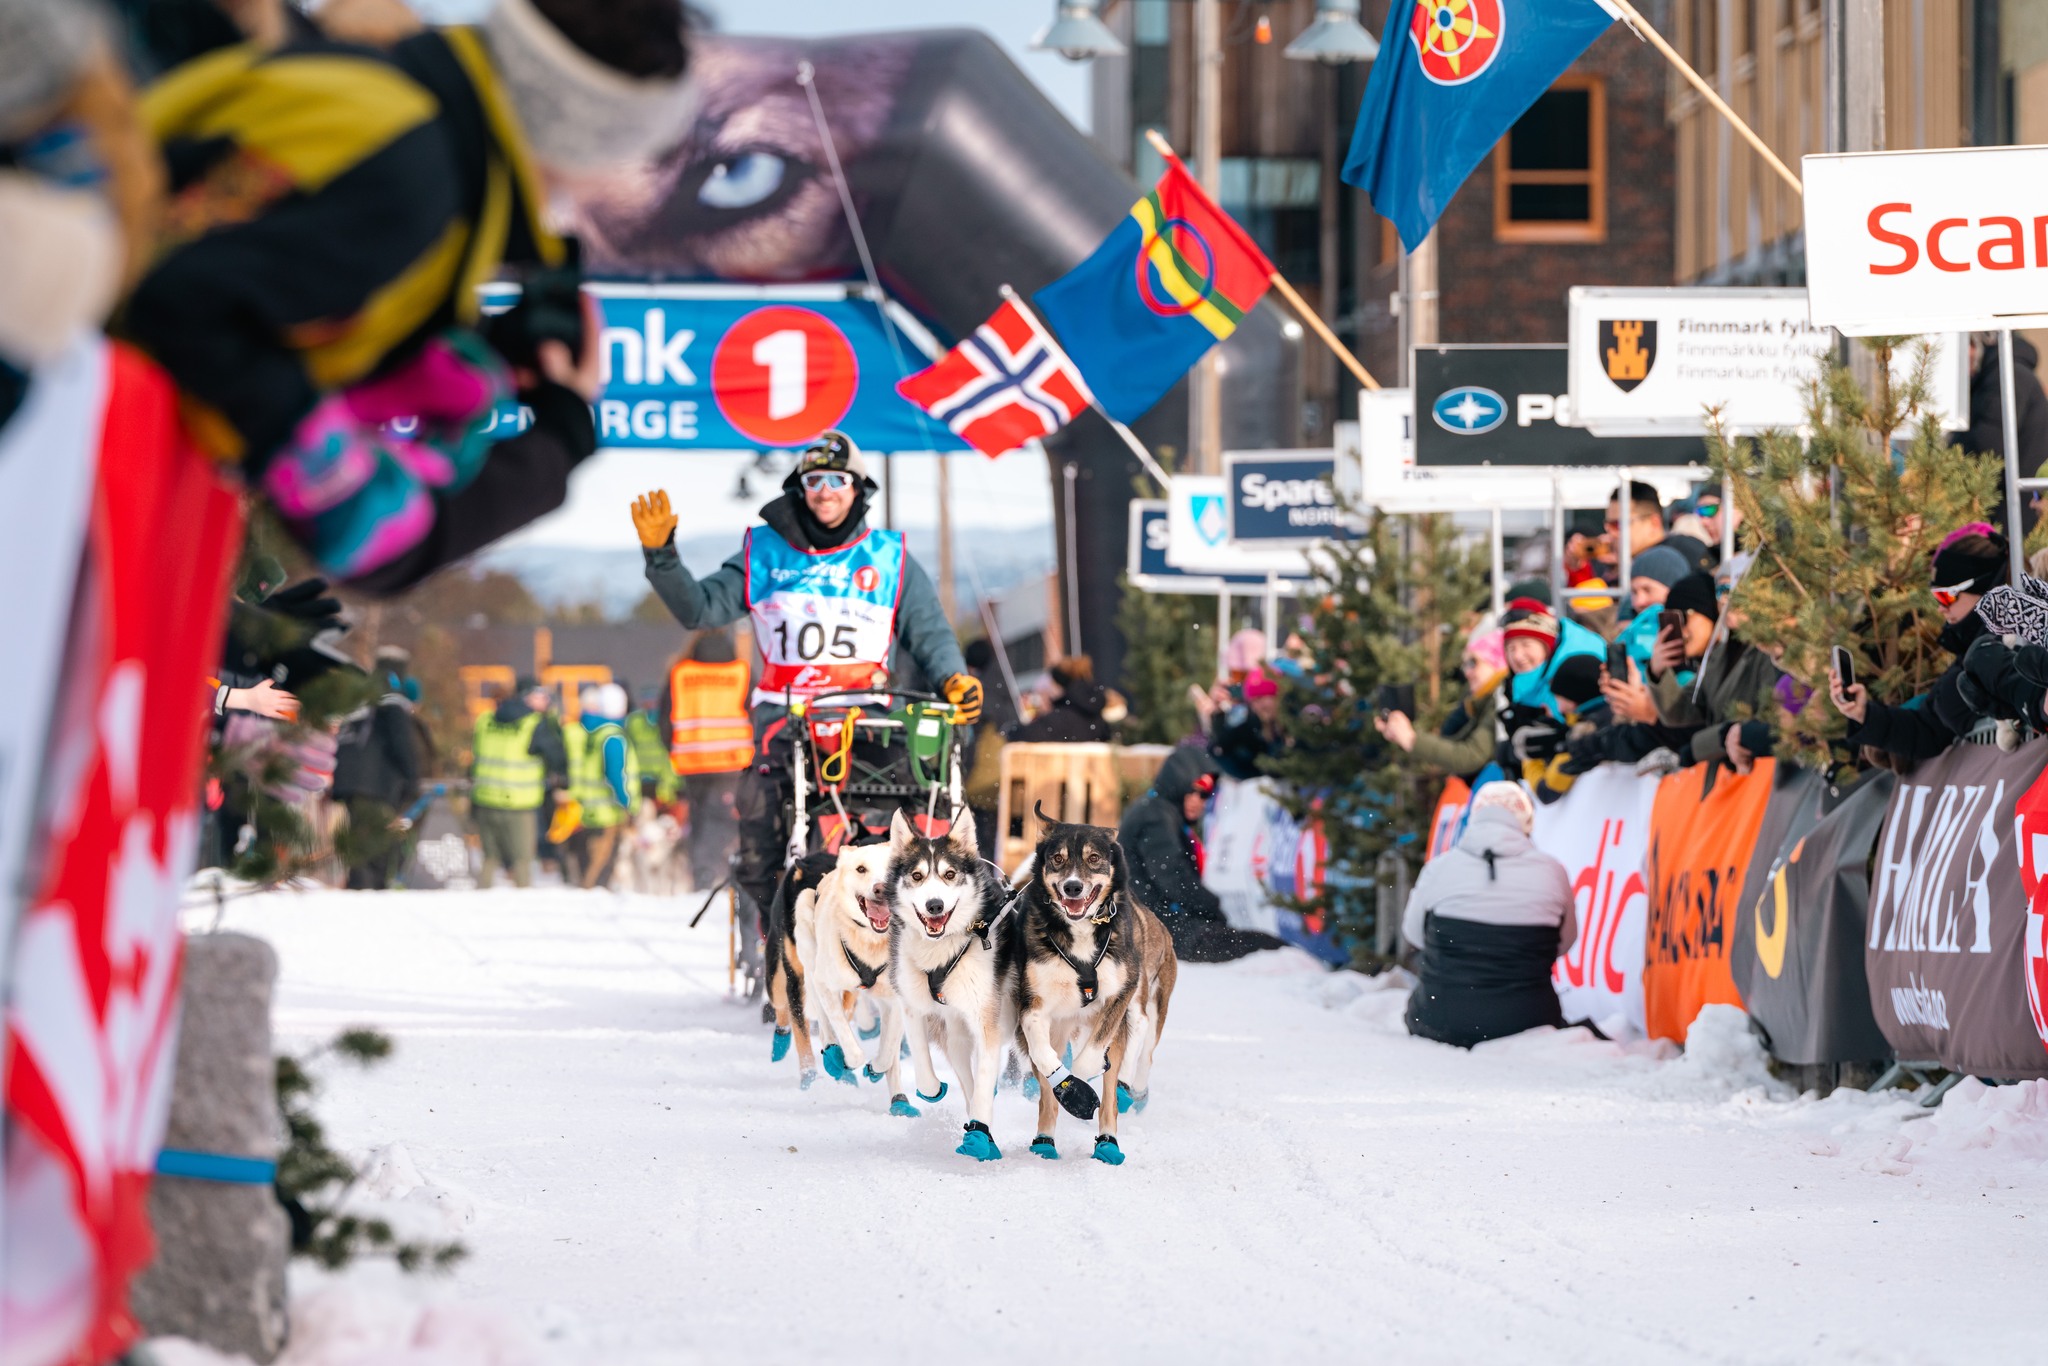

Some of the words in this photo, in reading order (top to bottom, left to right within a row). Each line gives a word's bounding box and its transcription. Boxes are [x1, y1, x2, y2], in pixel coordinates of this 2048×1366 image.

[1678, 319, 1773, 334] Finnmark
[752, 329, 808, 421] 1
[774, 620, 858, 661] 105
